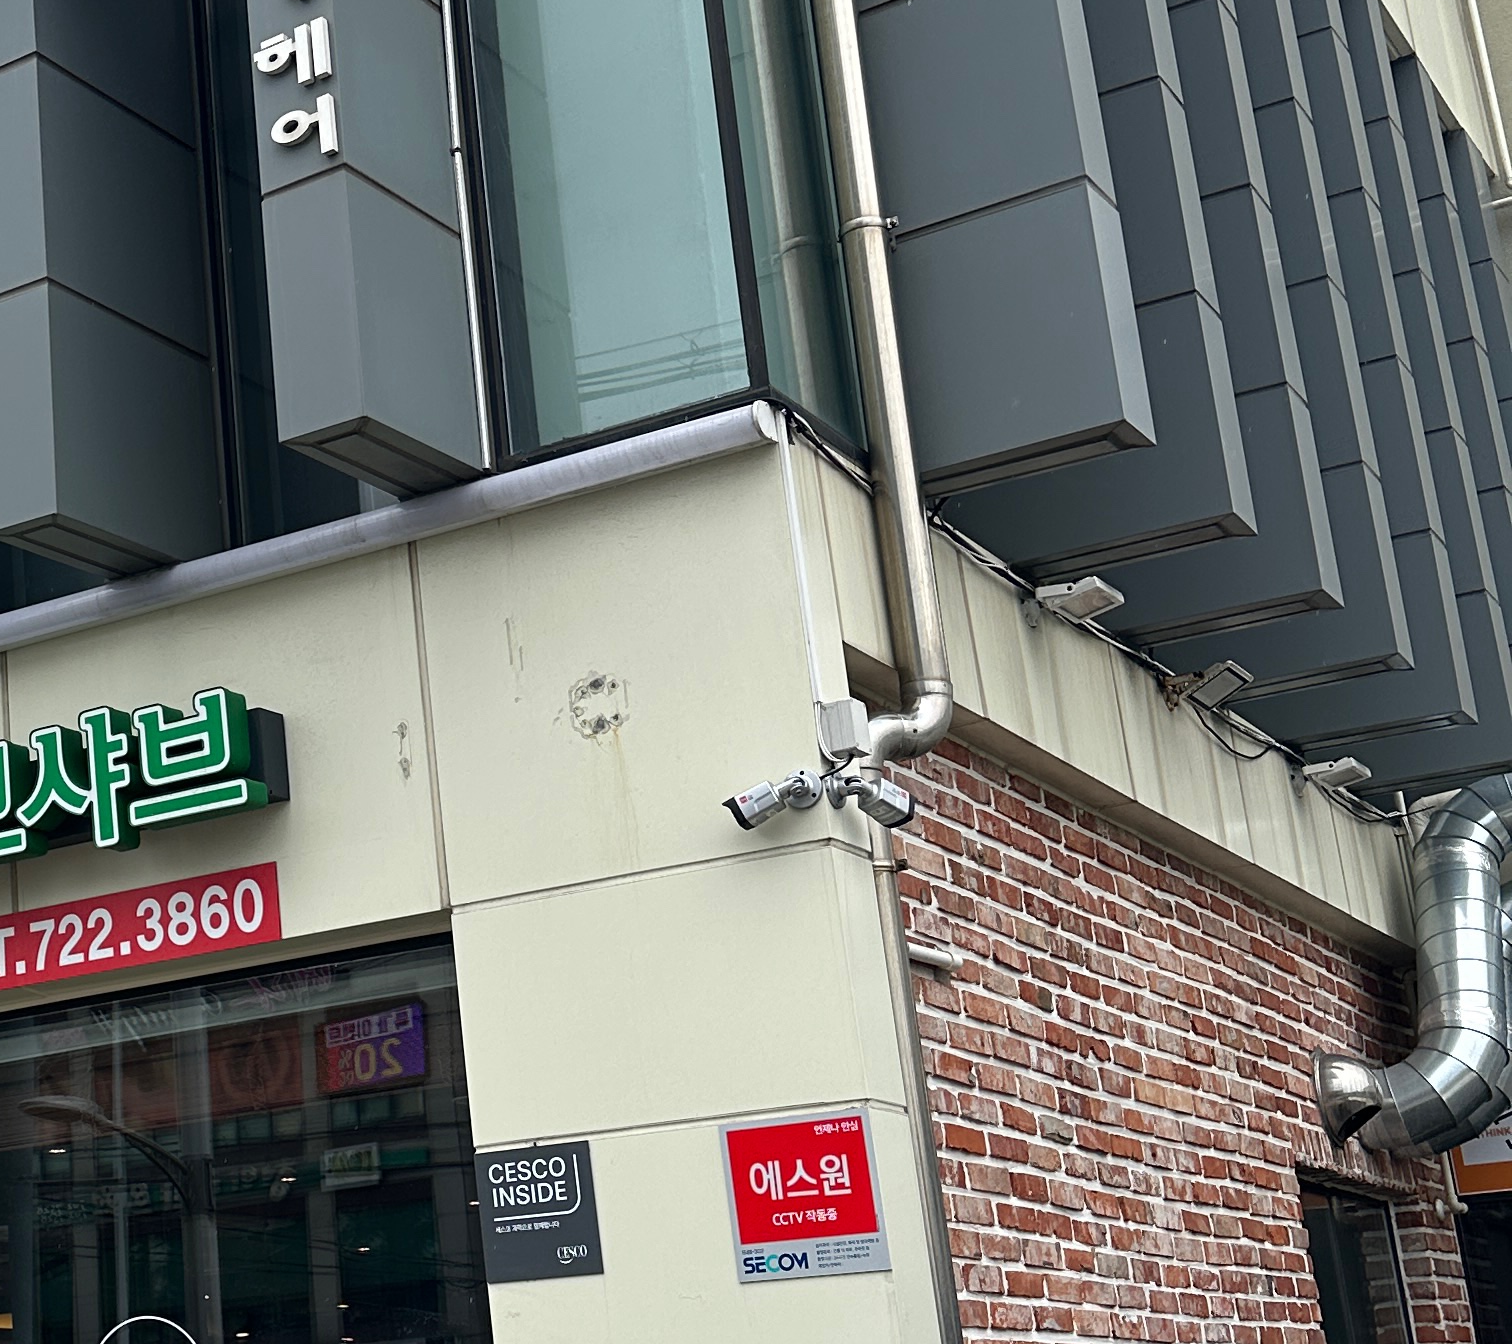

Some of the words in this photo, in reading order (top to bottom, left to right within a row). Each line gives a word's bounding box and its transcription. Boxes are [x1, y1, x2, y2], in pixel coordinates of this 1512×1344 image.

[487, 1156, 567, 1185] CESCO
[748, 1153, 853, 1202] 에스원
[492, 1180, 568, 1208] INSIDE
[772, 1210, 804, 1227] CCTV
[804, 1207, 838, 1224] 작동중
[556, 1244, 588, 1260] CESCO
[742, 1251, 810, 1275] SECOM
